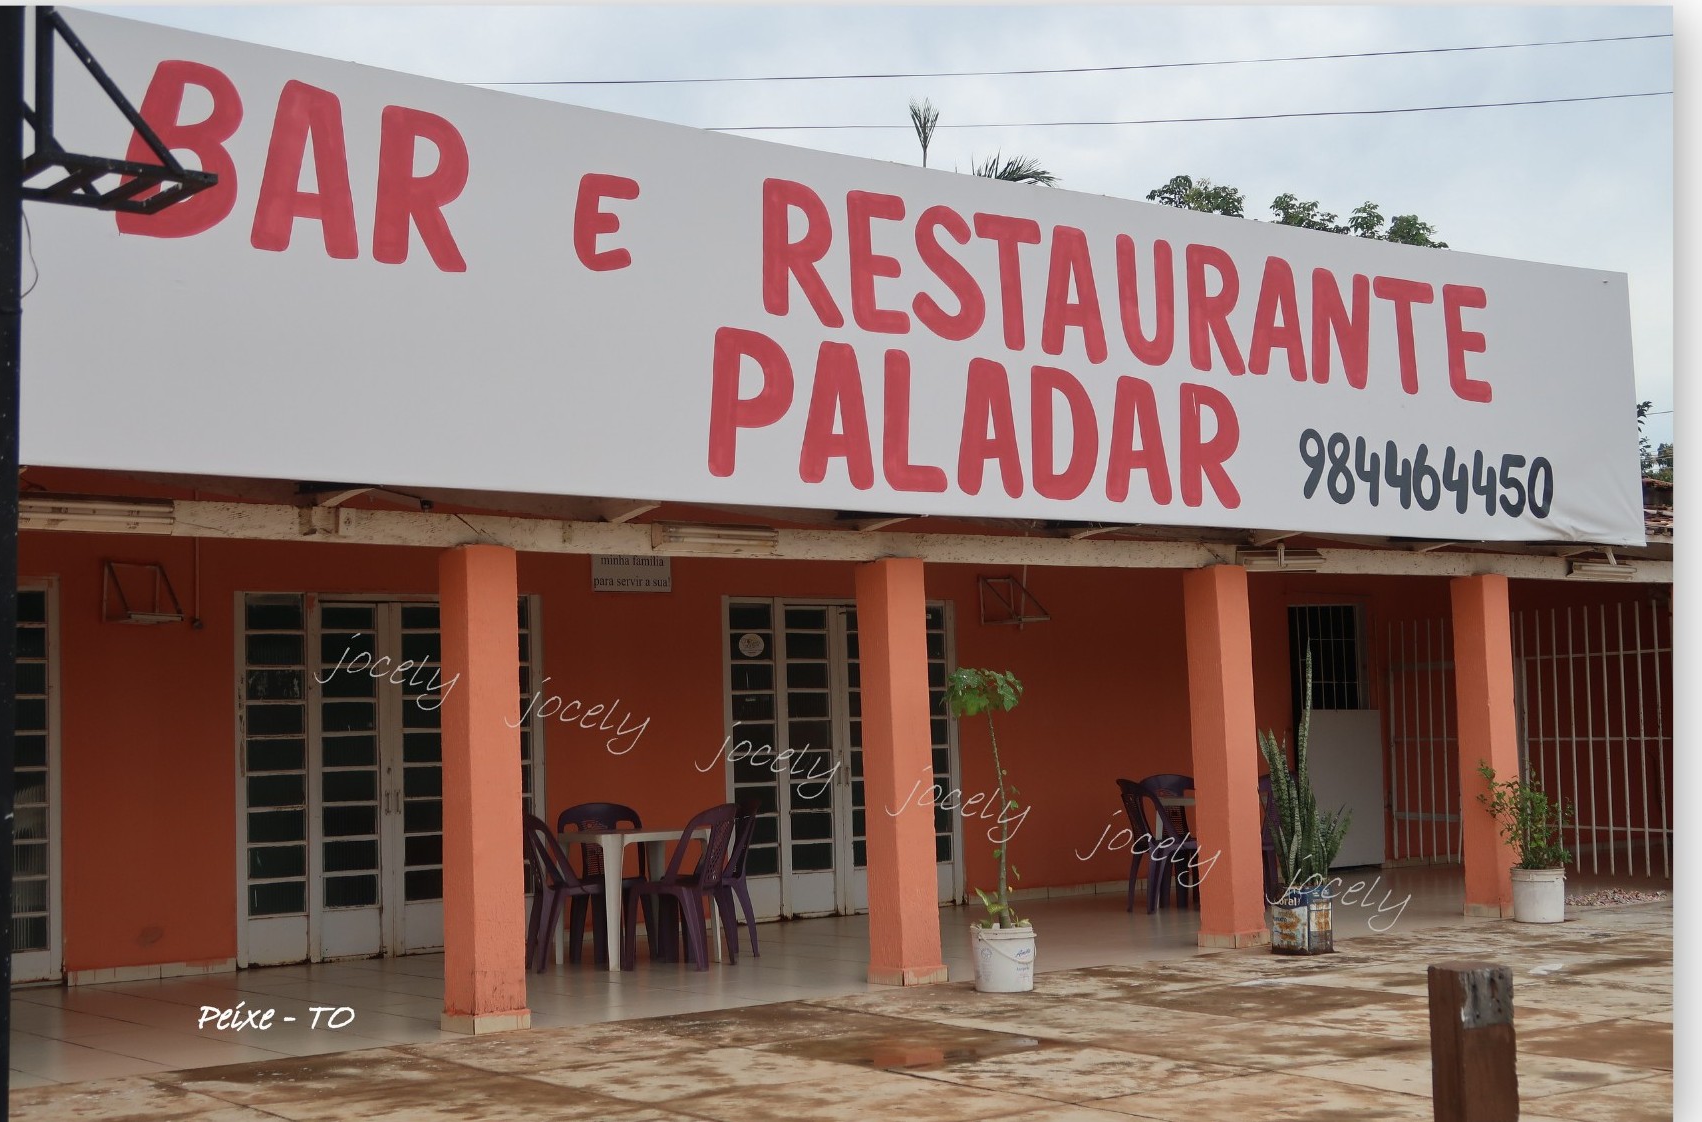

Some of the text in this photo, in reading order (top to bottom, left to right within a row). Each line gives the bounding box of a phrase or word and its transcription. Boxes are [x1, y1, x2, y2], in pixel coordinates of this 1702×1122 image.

[117, 59, 1494, 404] BAR E RESTAURANTE
[707, 326, 1241, 510] PALADAR
[1299, 428, 1554, 519] 984464450
[594, 577, 614, 588] para
[617, 576, 643, 587] servir
[601, 555, 629, 565] minha
